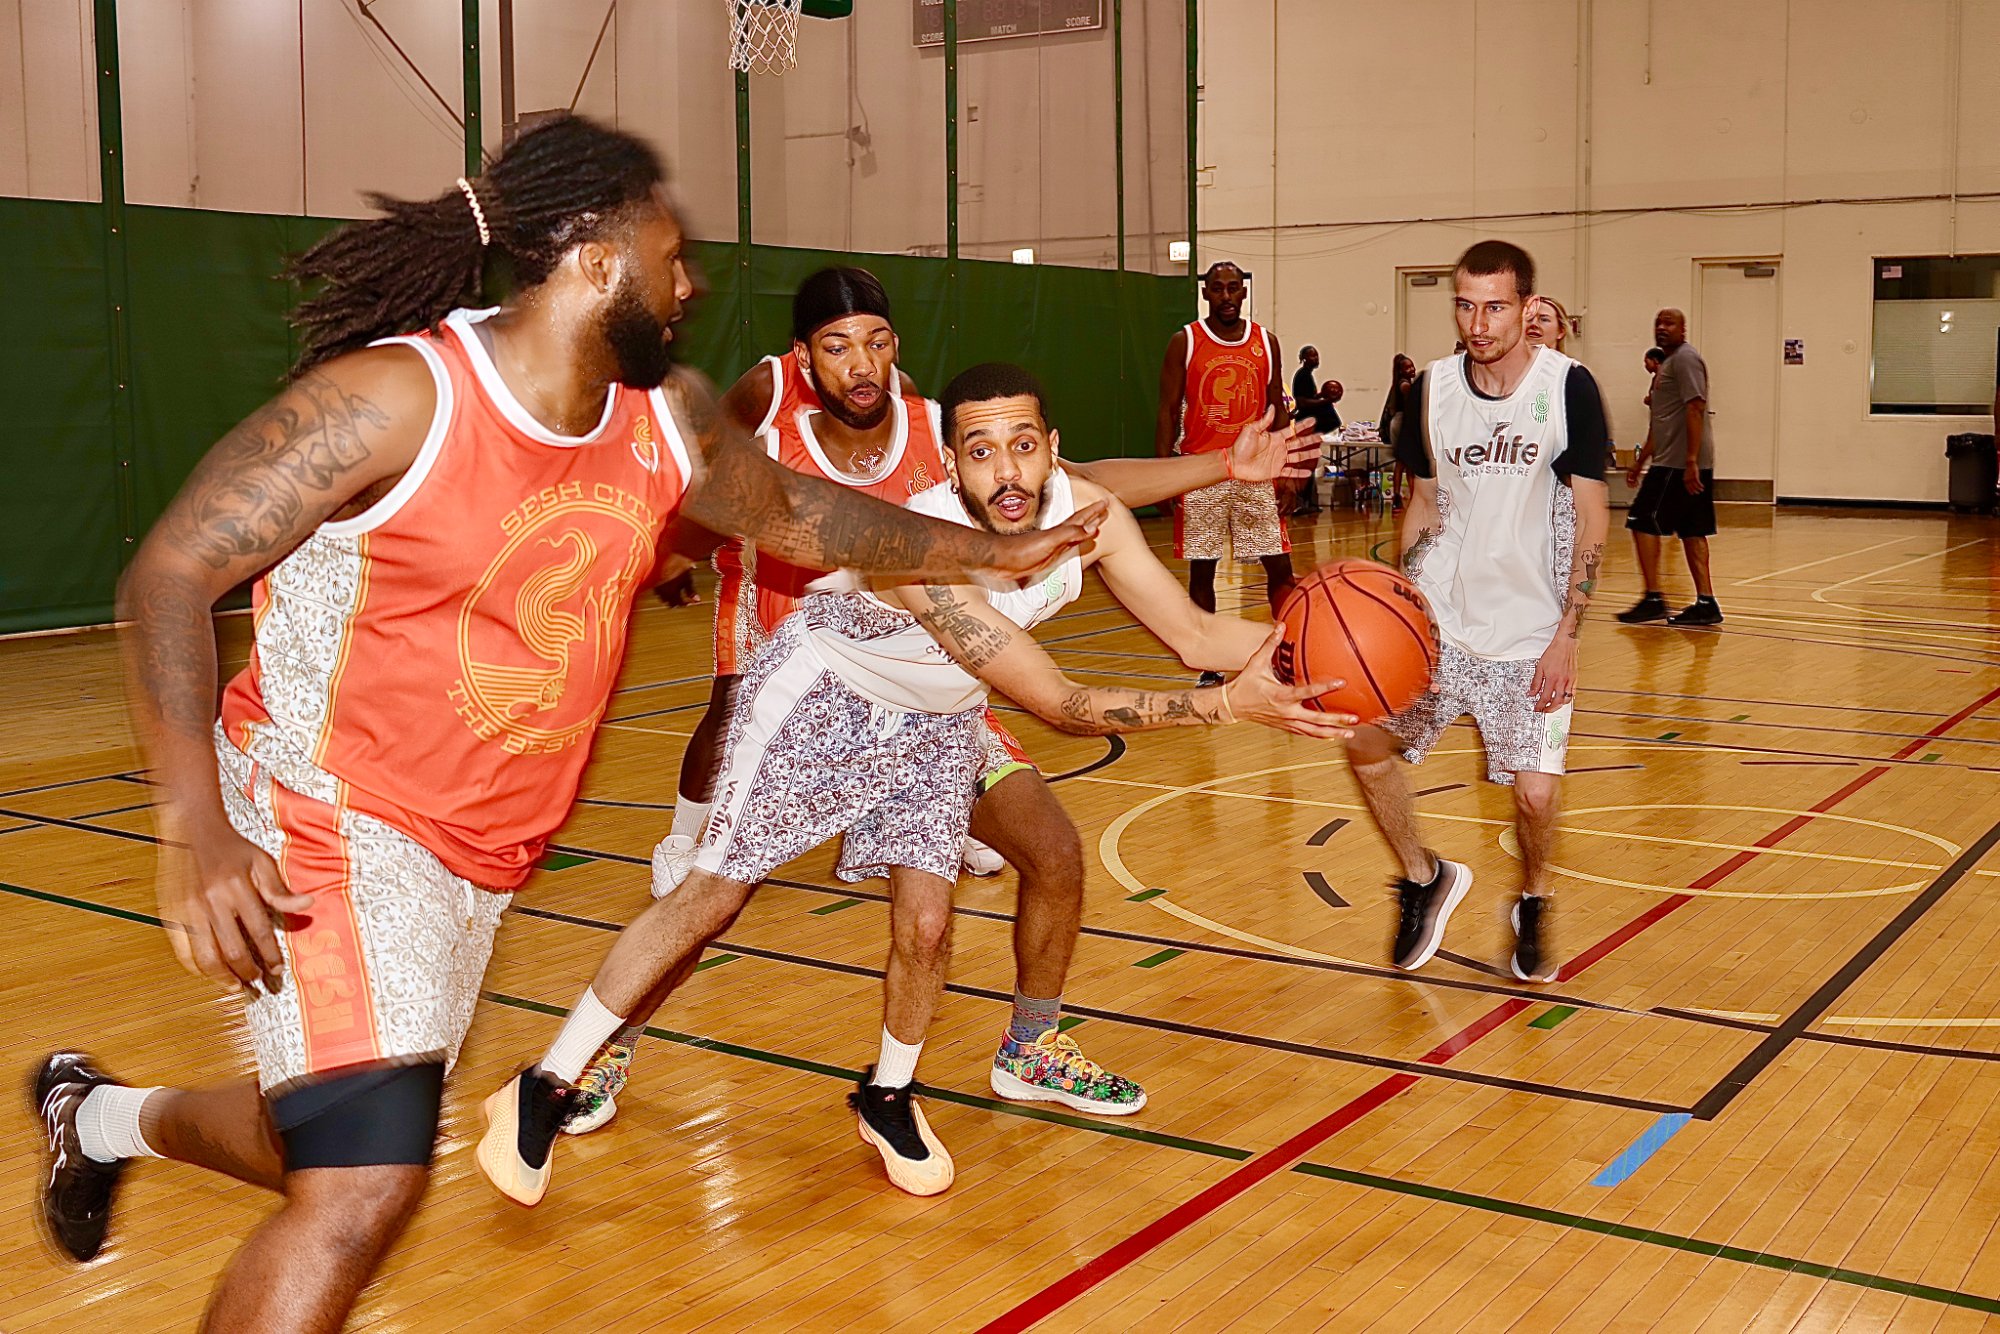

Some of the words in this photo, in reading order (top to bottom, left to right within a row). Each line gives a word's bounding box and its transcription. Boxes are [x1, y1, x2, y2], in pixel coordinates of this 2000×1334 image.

[1065, 15, 1092, 28] SCORE
[990, 23, 1017, 35] MATCH
[920, 31, 945, 44] SCORE
[499, 480, 584, 538] SESH
[592, 481, 659, 531] CITY
[446, 678, 501, 742] THE
[500, 725, 585, 756] BEST
